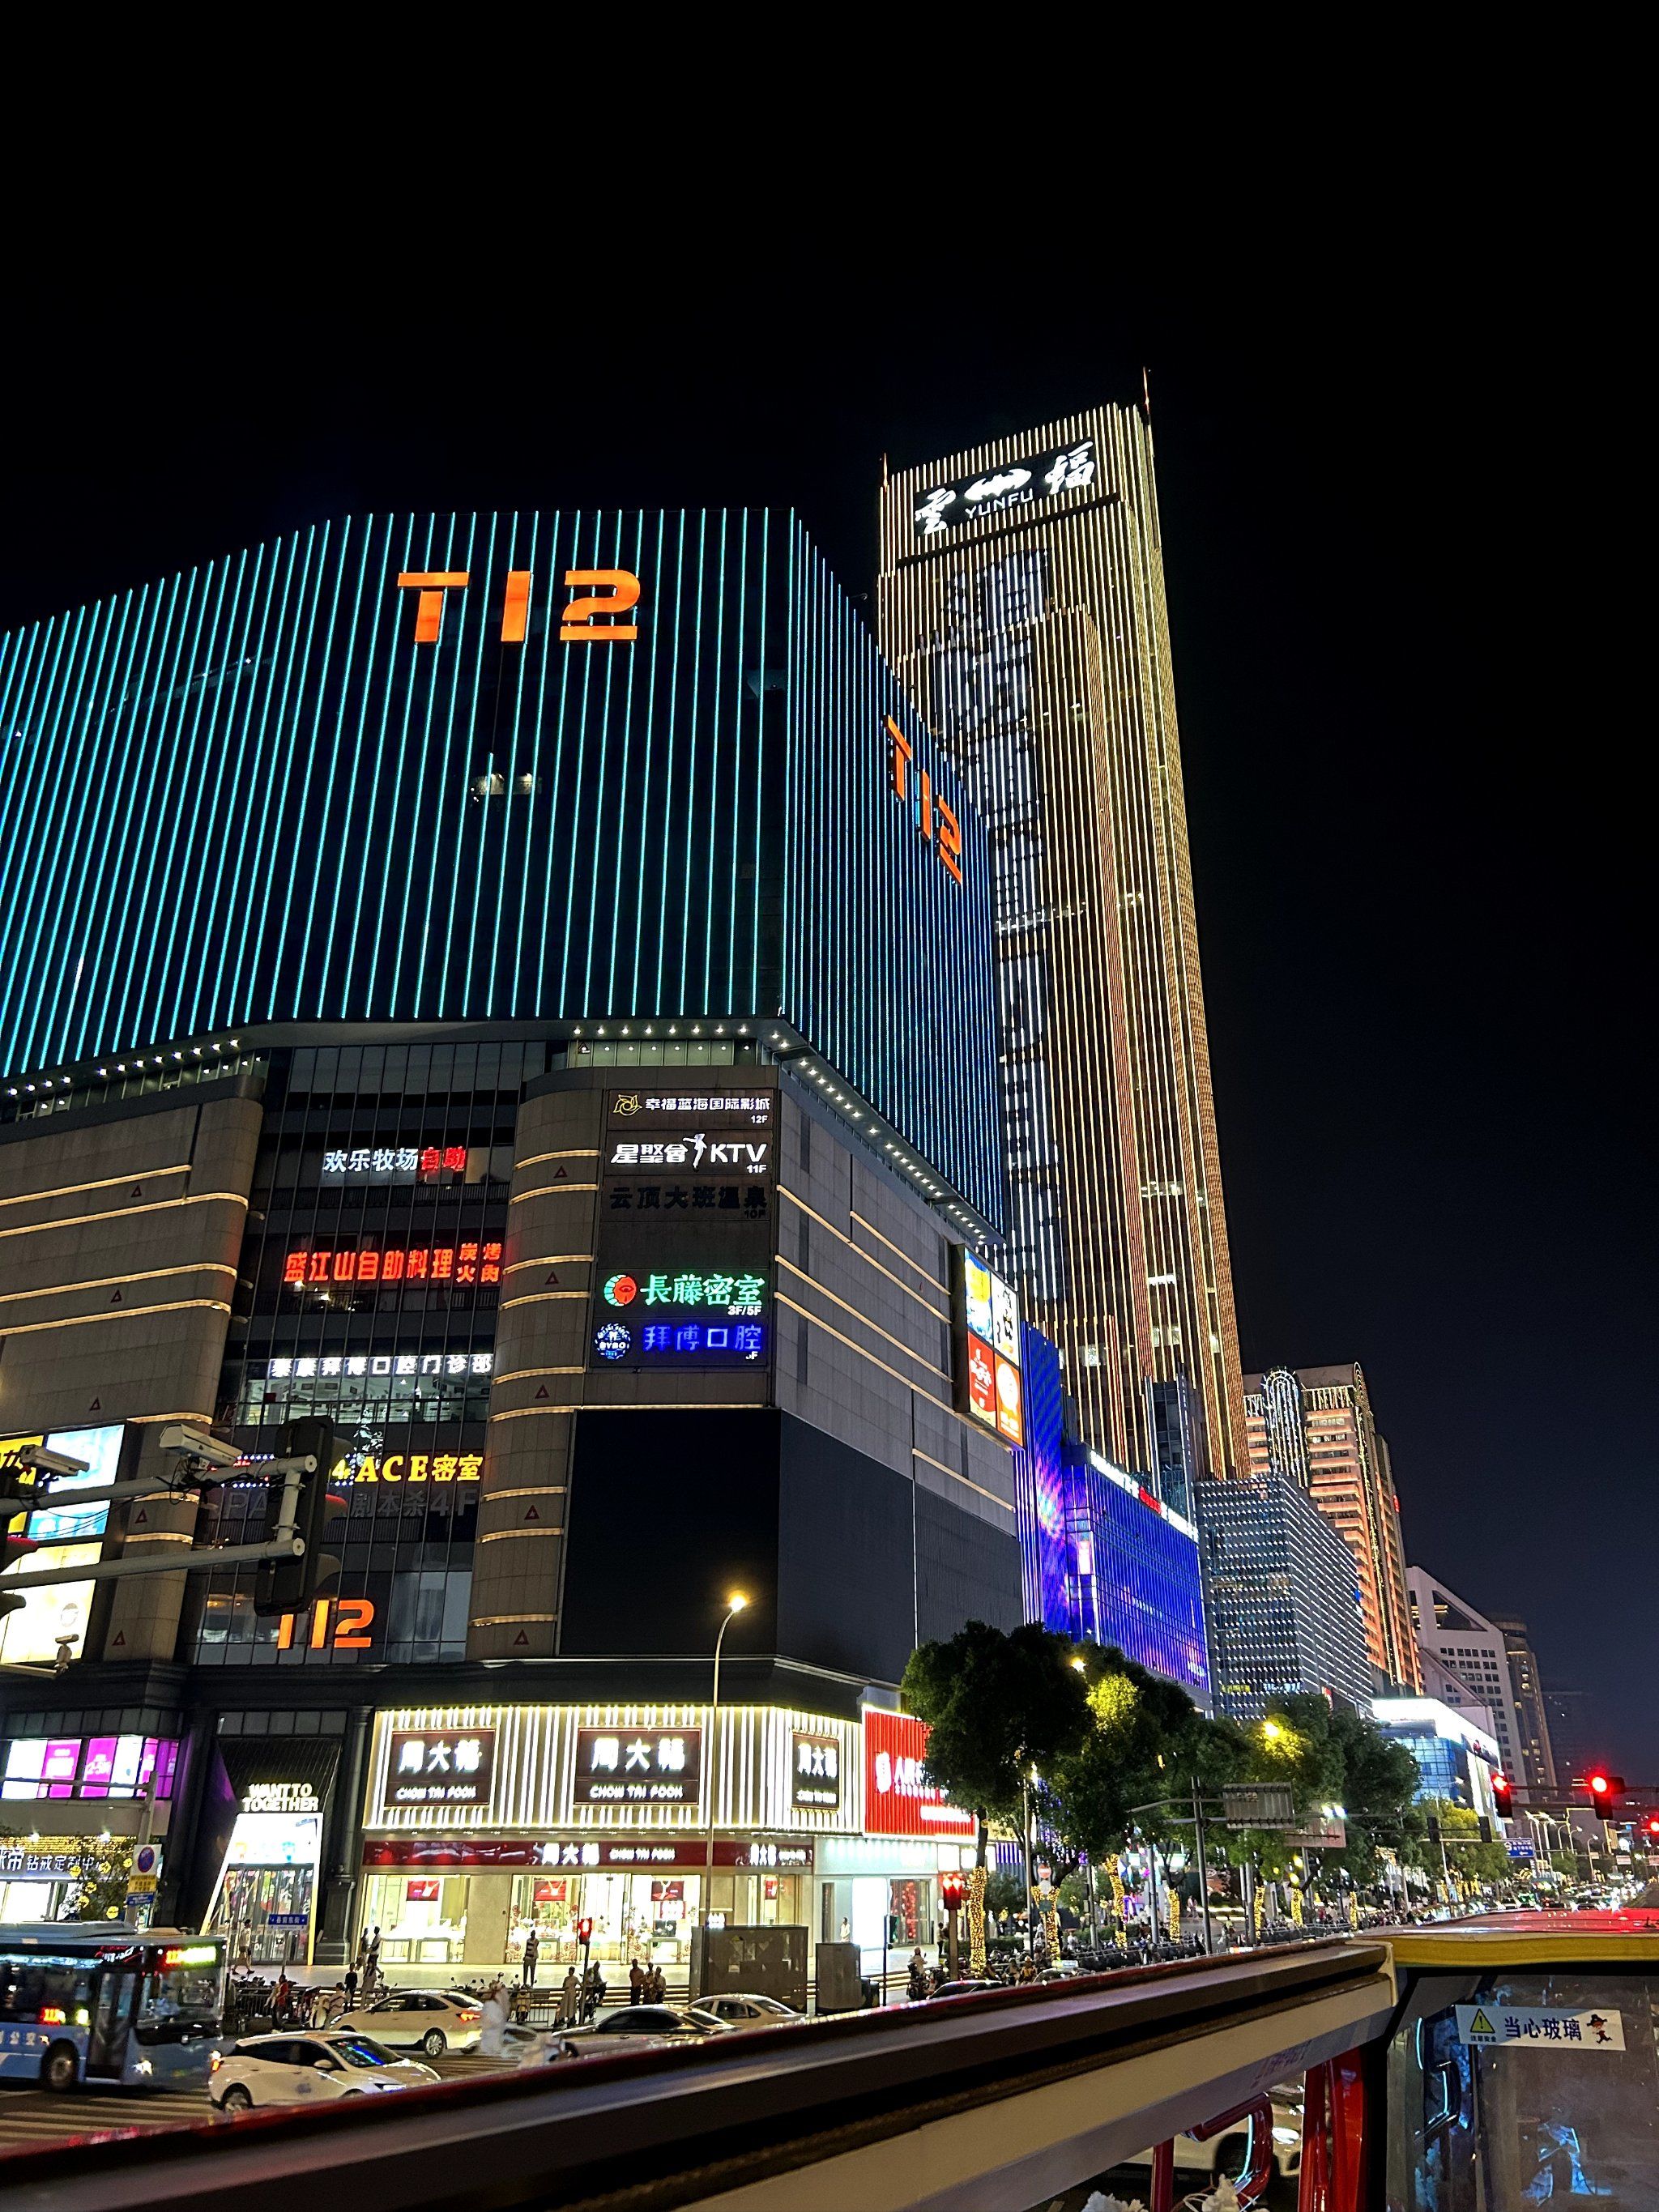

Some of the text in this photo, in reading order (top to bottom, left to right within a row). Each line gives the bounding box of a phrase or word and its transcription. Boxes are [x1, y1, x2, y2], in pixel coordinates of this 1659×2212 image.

[965, 488, 1033, 518] YUNFU
[398, 570, 640, 642] T12
[887, 714, 962, 885] T12
[645, 1097, 770, 1111] 幸福蓝海国际影城
[750, 1115, 767, 1123] 12F
[710, 1143, 767, 1163] KTV
[746, 1164, 767, 1174] 11F
[727, 1305, 761, 1316] 3F/5F
[643, 1326, 761, 1351] 拜博口腔
[249, 1783, 313, 1798] WANT TO
[242, 1796, 319, 1812] TOGETHER
[1504, 2016, 1583, 2041] 当心玻璃
